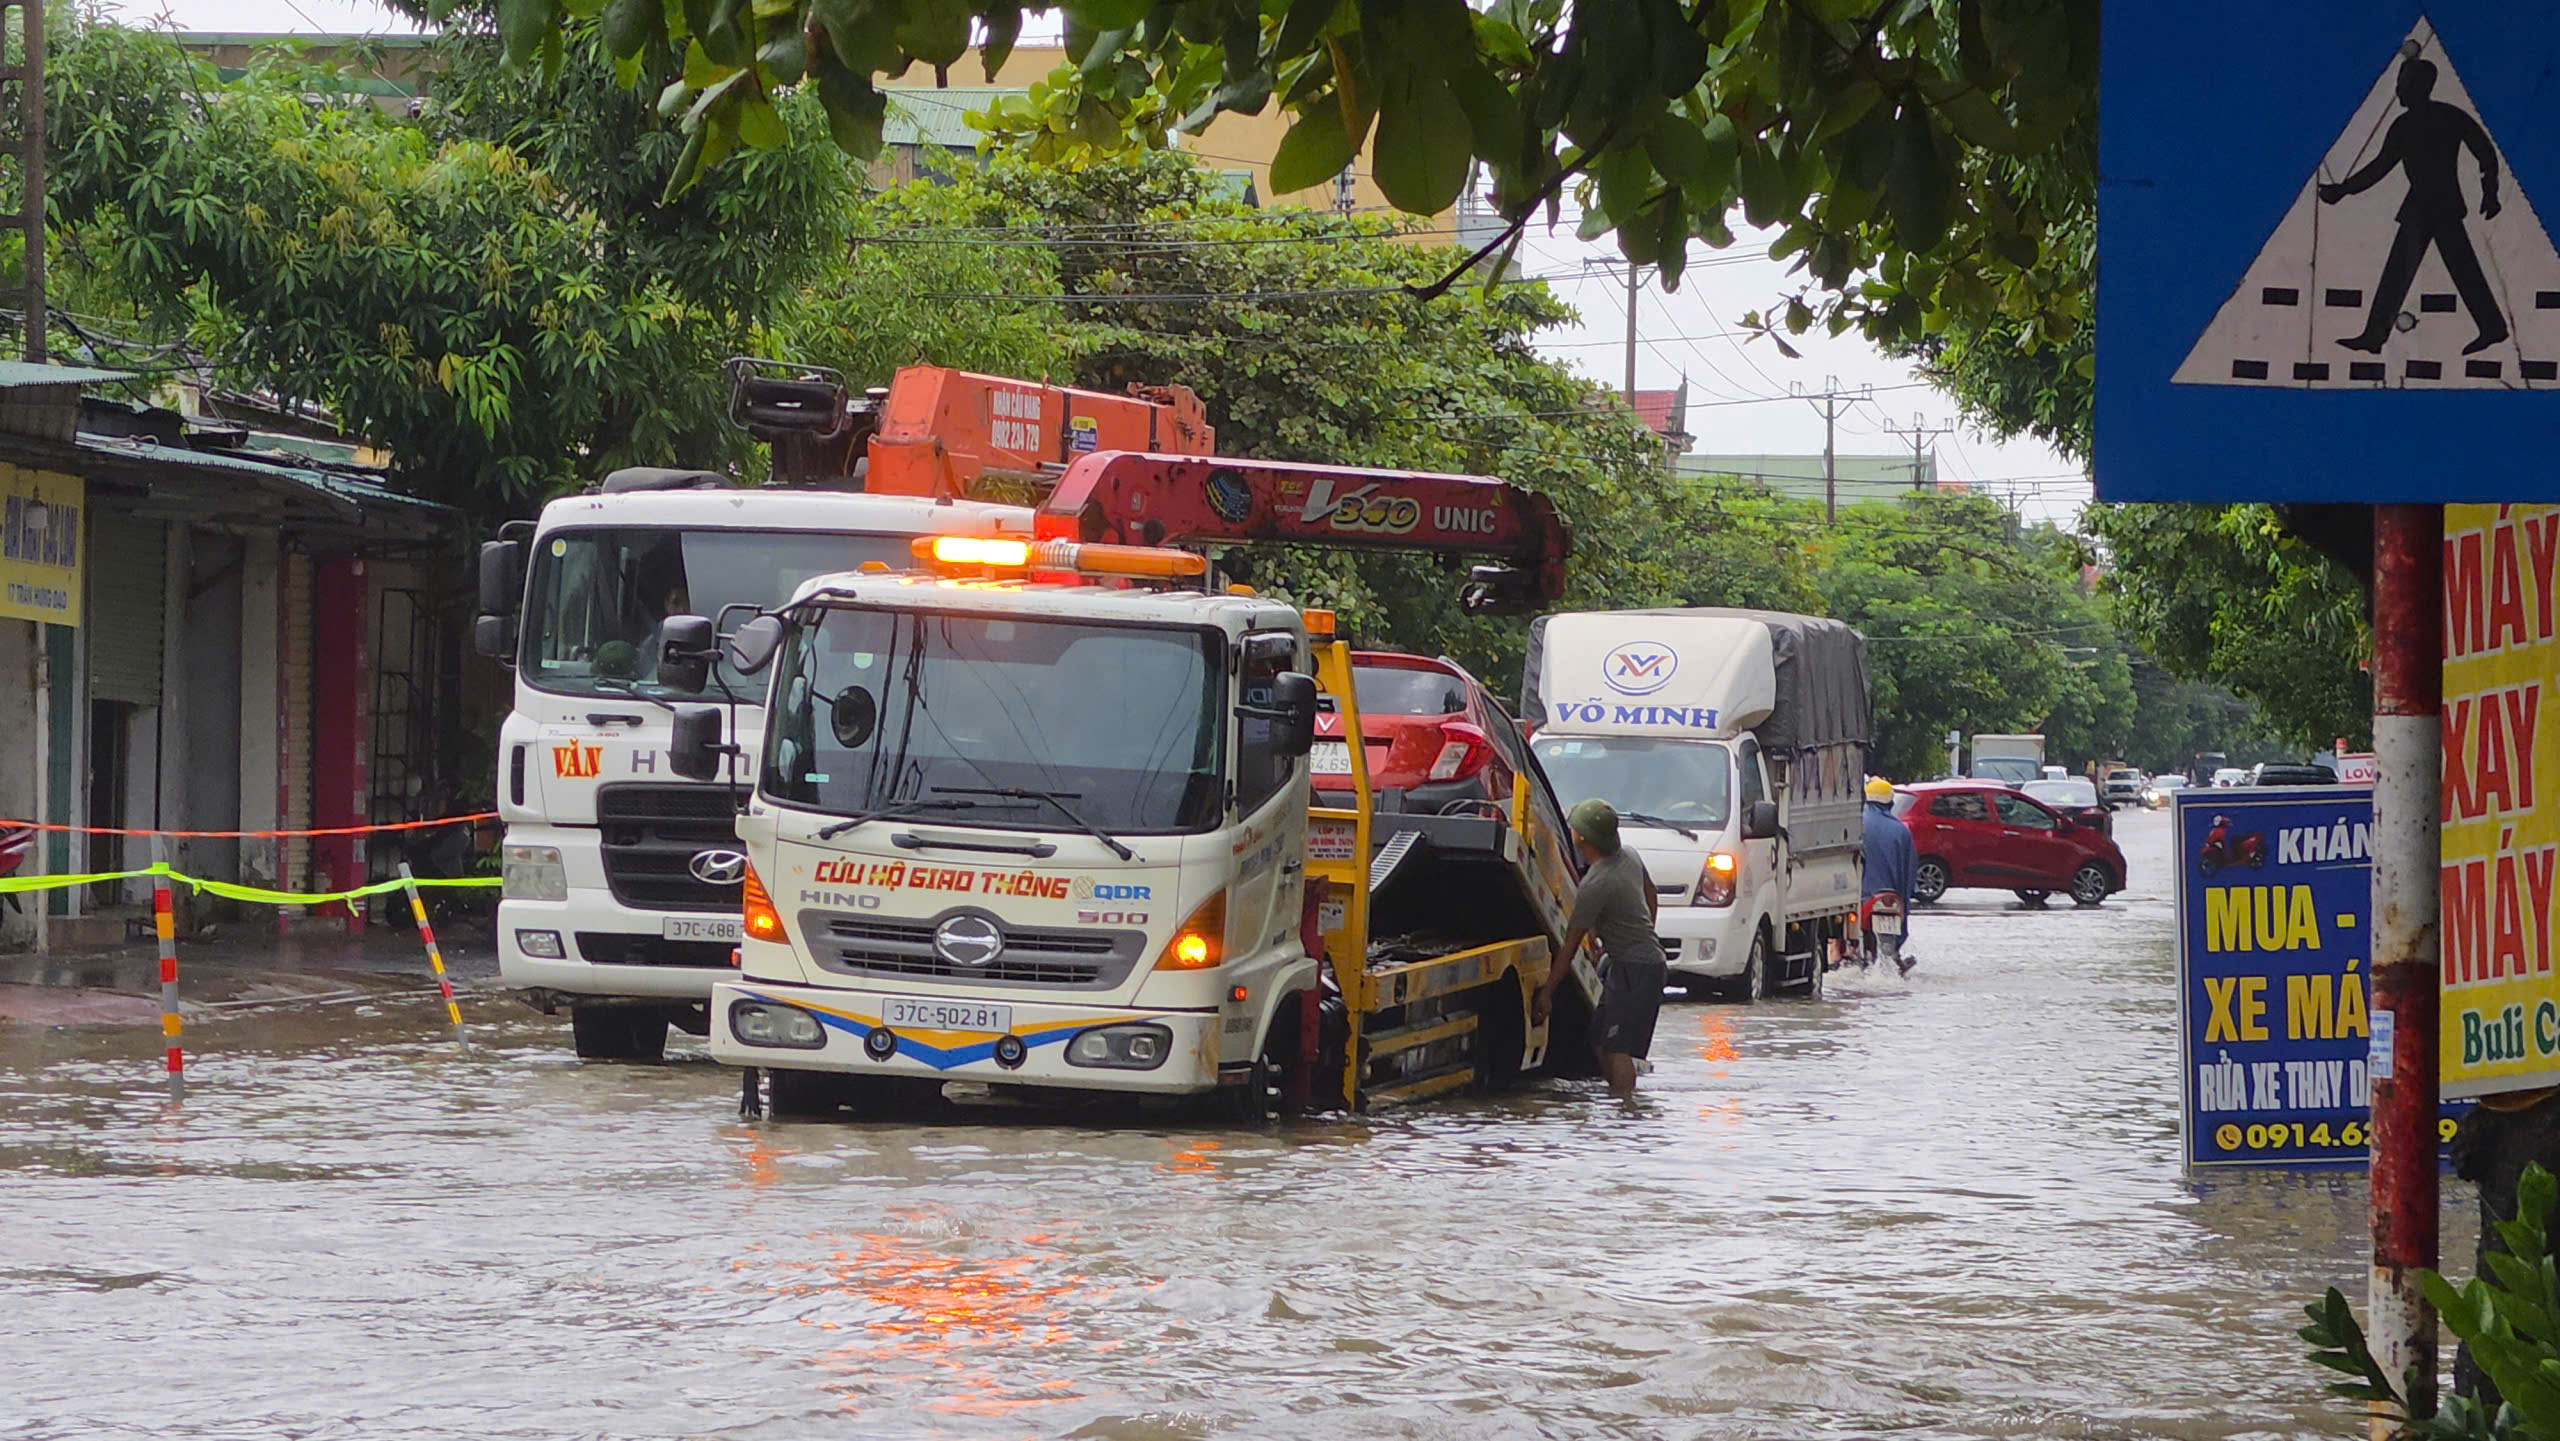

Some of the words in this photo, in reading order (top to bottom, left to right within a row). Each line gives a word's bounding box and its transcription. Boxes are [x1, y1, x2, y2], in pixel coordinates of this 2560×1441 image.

[1433, 505, 1496, 533] UNIC
[2443, 504, 2560, 660] MÁY
[1556, 697, 1606, 723] VÕ
[1612, 705, 1719, 730] MINH
[2345, 768, 2374, 779] LOV
[2278, 816, 2373, 864] KHÁN
[800, 889, 881, 909] HINO
[814, 856, 864, 886] CỨU
[868, 862, 906, 892] HỘ
[908, 867, 973, 892] GIAO
[981, 870, 1071, 899] THÔNG
[1094, 884, 1151, 900] QDR
[1078, 911, 1149, 925] 500
[2205, 885, 2321, 952] MUA
[2441, 827, 2555, 986] MÁY
[893, 1004, 998, 1028] 37C-502.81
[2203, 977, 2269, 1042] XE
[2287, 958, 2370, 1040] MÁ
[2462, 1005, 2526, 1065] Buli
[2200, 1049, 2248, 1112] RỬA
[2251, 1062, 2281, 1110] XE
[2285, 1060, 2344, 1110] THAY
